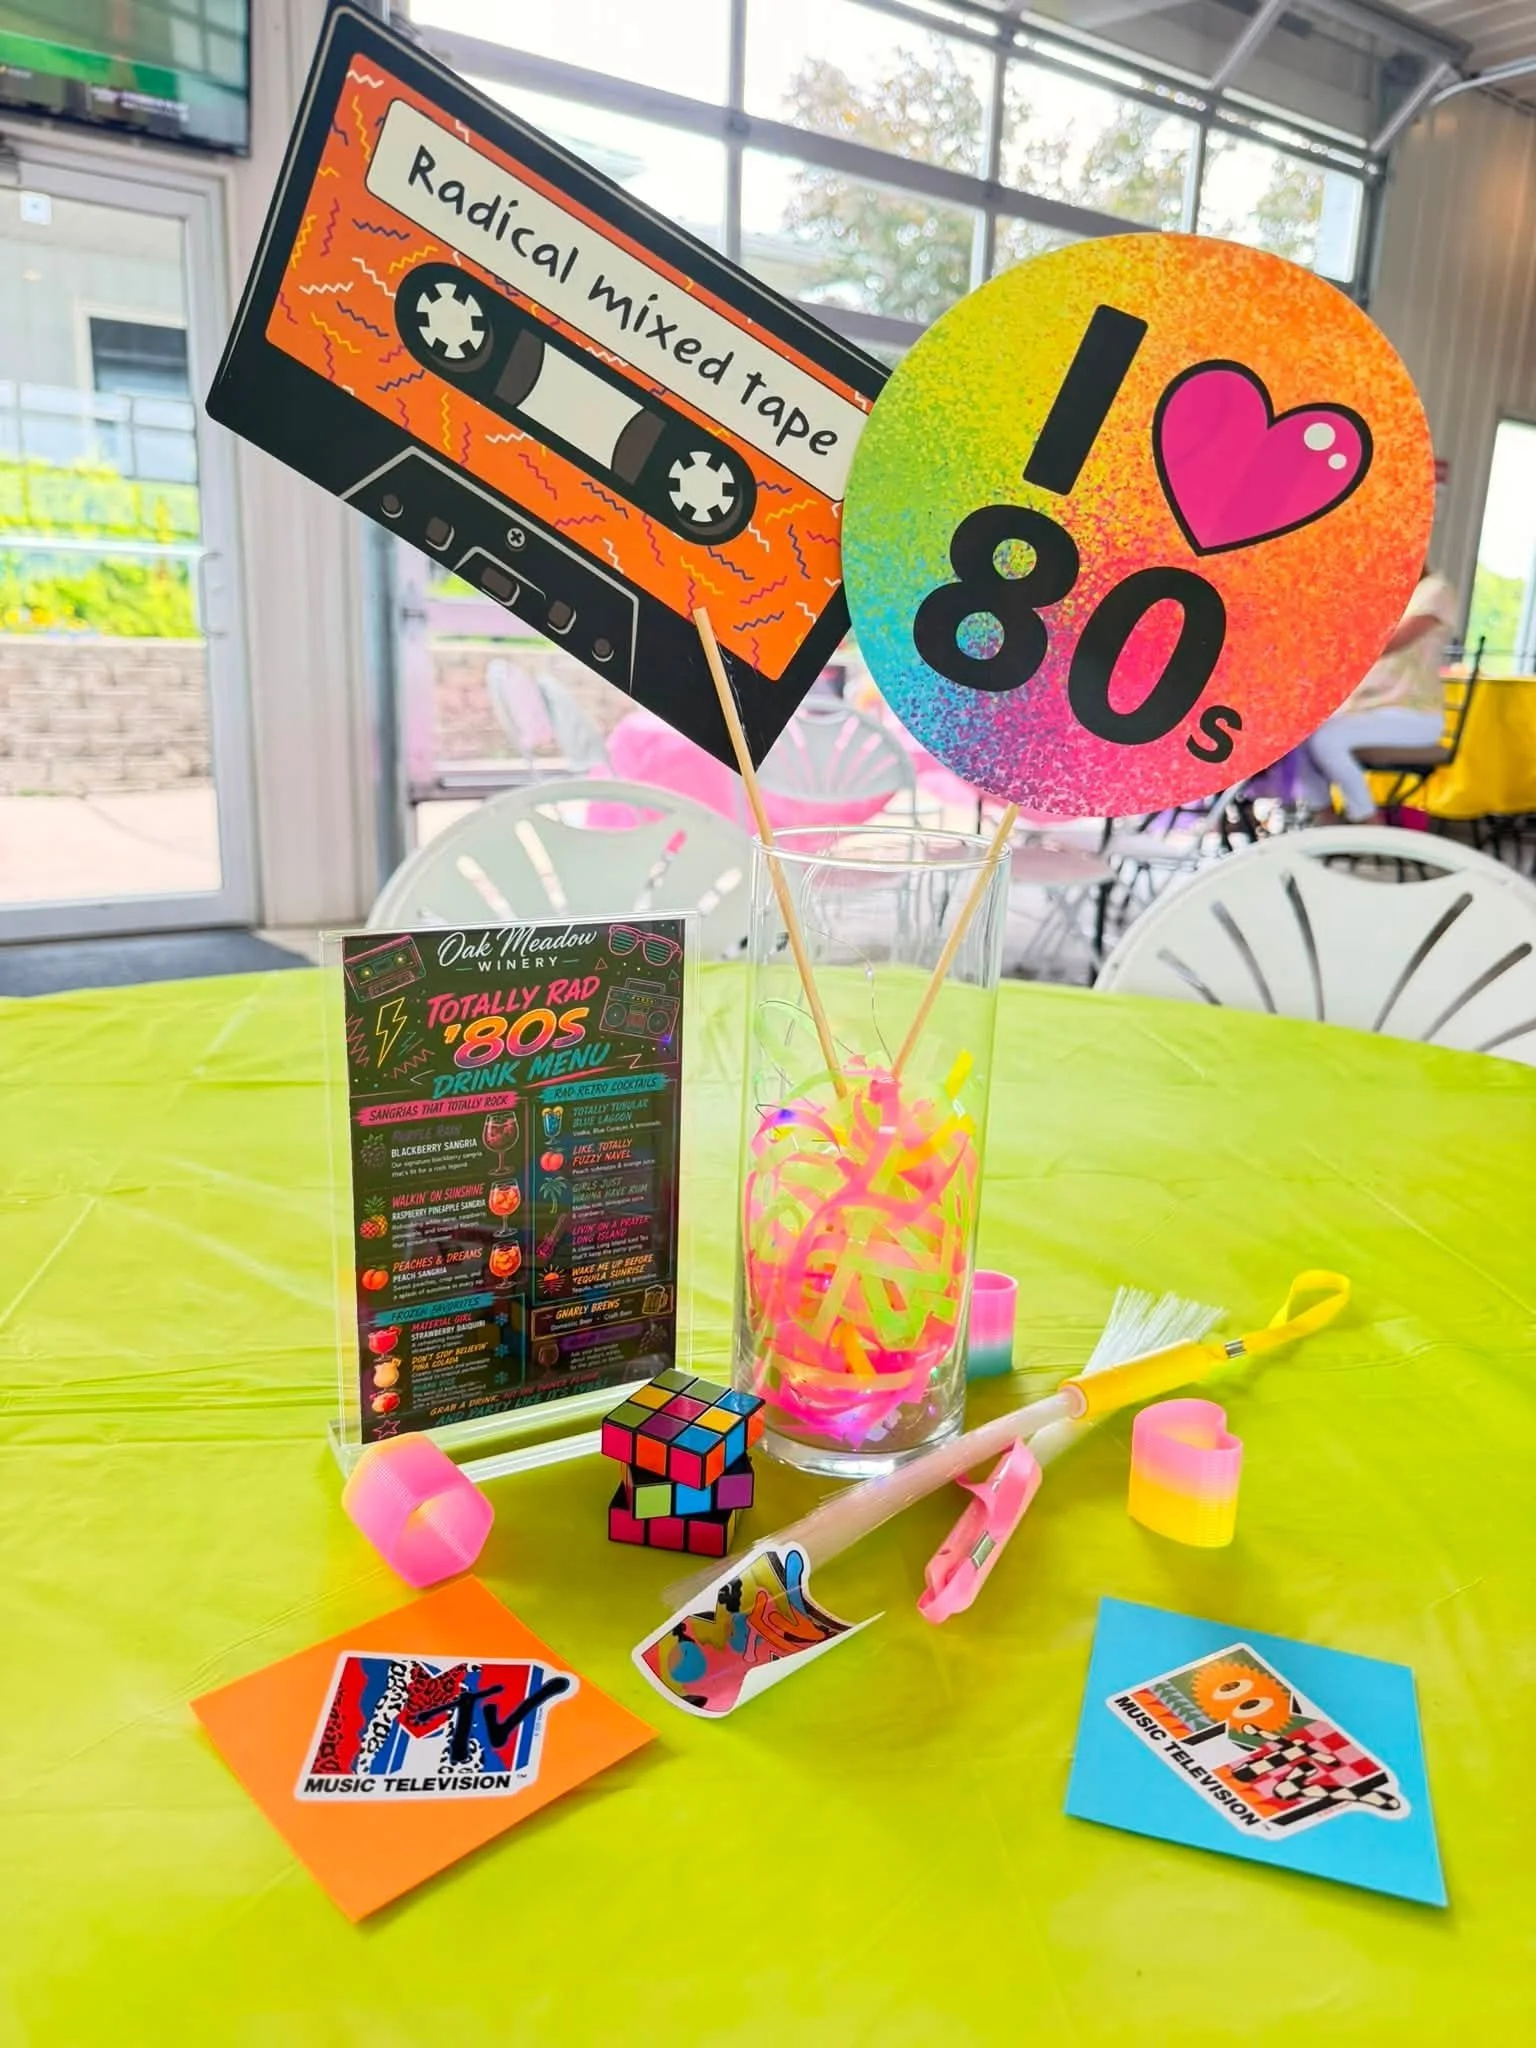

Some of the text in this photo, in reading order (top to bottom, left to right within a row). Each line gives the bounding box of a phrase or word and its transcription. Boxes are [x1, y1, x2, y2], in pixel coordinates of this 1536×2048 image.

[408, 144, 838, 455] Radical mixed tape
[1023, 304, 1148, 496] I
[437, 924, 598, 967] Oak Meadow
[478, 956, 559, 972] WINERY
[427, 975, 600, 1028] TOTALLY RAD
[433, 1042, 610, 1099] DRINK MENU
[554, 1077, 657, 1098] RAD RETRO COCKTAILS
[369, 1095, 508, 1121] SANGRIAS THAT TOTALLY ROCK
[573, 1104, 607, 1116] TOTALLY
[573, 1117, 597, 1128] BLUE
[599, 1111, 633, 1123] LAGOON
[392, 1138, 477, 1158] BLACKBERRY SANGRIA
[598, 1139, 633, 1152] TOTALLY
[572, 1150, 631, 1166] FUZZY NAVEL
[430, 1191, 442, 1201] ON
[444, 1184, 486, 1200] SUNSHINE
[572, 1184, 648, 1203] WANNA HAVE RUM
[573, 1177, 623, 1193] GIRLS JUST
[392, 1199, 486, 1220] RASPBERRY PINEAPPLE SANGRIA
[598, 1222, 608, 1230] ON
[572, 1229, 628, 1246] LONG ISLAND
[392, 1248, 483, 1272] PEACHES & DREAMS
[572, 1254, 654, 1277] WAKE ME UP BEFORE
[392, 1271, 416, 1282] PEACH
[418, 1267, 448, 1278] SANGRIA
[573, 1272, 606, 1285] TEQUILA
[609, 1264, 646, 1278] SUNRISE
[392, 1297, 480, 1321] FROZEN FAVORITES
[556, 1298, 621, 1320] GNARLY BREWS
[411, 1314, 472, 1332] MATERIAL GIRL
[411, 1320, 486, 1341] STRAWBERRY DAIQUIRI
[412, 1353, 434, 1365] DON'T
[436, 1349, 454, 1359] STOP
[431, 1356, 459, 1368] COLADA
[430, 1405, 459, 1416] GRAB
[435, 1411, 465, 1426] AND
[468, 1401, 511, 1418] PARTY
[310, 1656, 570, 1775] MTV
[1114, 1695, 1260, 1827] MUSIC TELEVISION
[304, 1778, 376, 1793] MUSIC
[384, 1775, 511, 1792] TELEVISION
